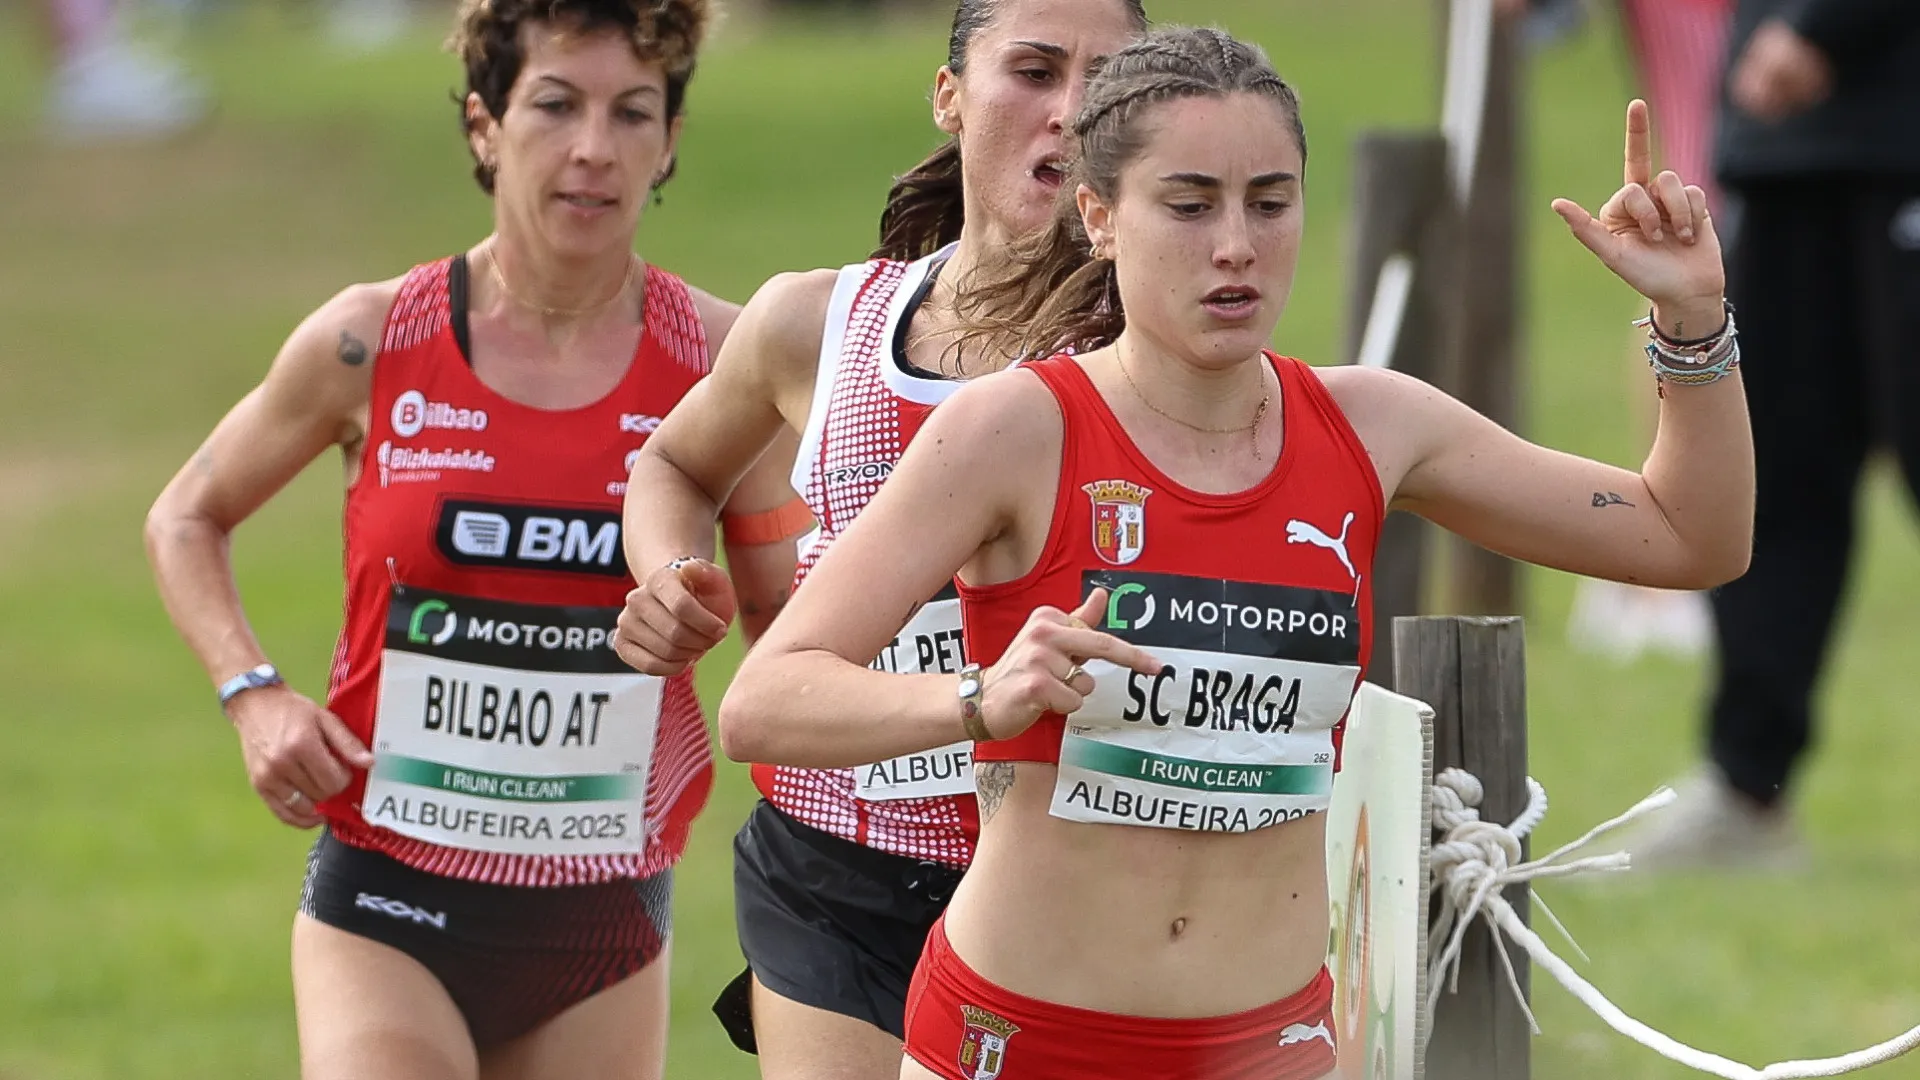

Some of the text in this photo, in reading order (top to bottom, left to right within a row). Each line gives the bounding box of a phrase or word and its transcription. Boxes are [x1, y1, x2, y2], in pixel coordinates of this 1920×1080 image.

[391, 389, 488, 438] Bilbao
[517, 516, 619, 566] BM
[1169, 598, 1347, 638] MOTORPOR
[424, 676, 610, 747] BILBAO AT
[1123, 664, 1302, 734] SC BRAGA
[443, 770, 450, 788] I
[453, 772, 497, 793] RUN
[867, 751, 973, 786] ALBUF
[1141, 758, 1147, 775] I
[1152, 761, 1198, 784] RUN
[375, 796, 628, 840] ALBUFEIRA 2025
[1066, 781, 1249, 832] ALBUFEIRA
[355, 892, 447, 930] KON
